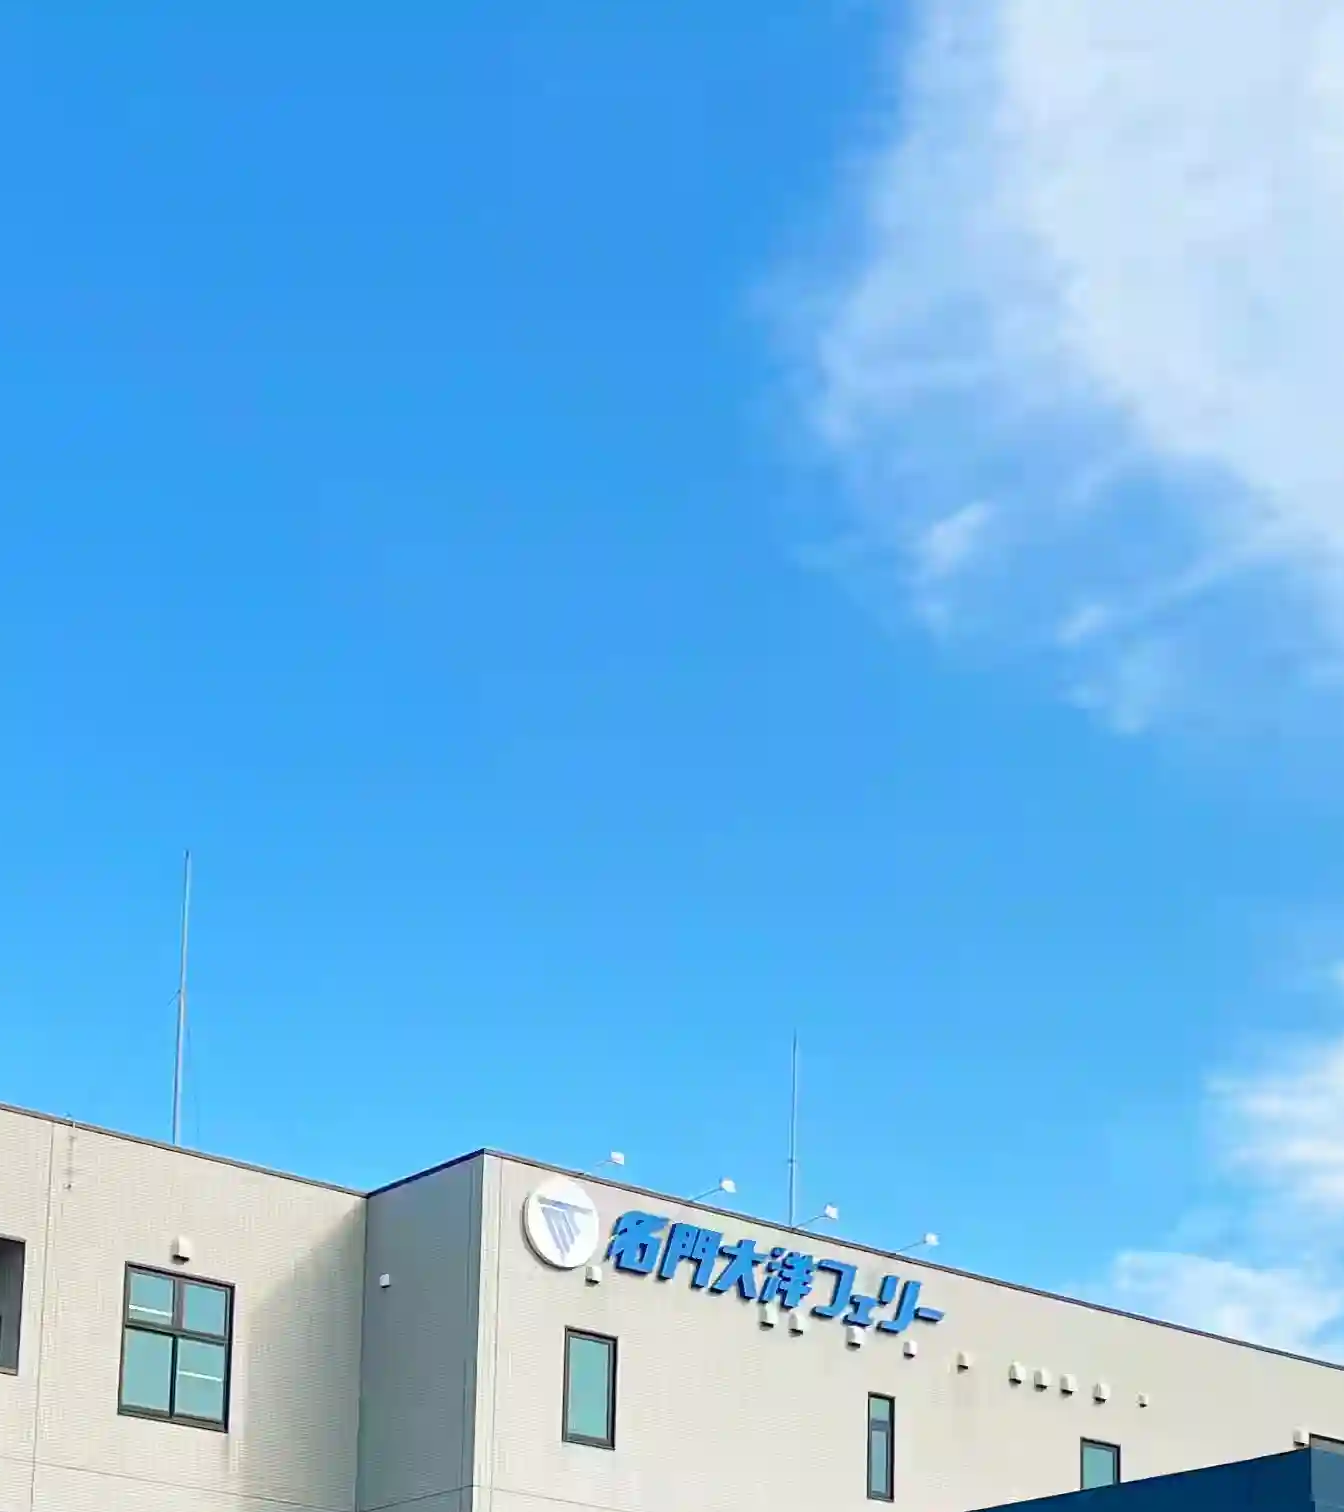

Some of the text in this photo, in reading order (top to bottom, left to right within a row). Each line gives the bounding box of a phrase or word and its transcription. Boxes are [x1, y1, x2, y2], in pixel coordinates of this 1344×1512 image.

[605, 1209, 945, 1334] 名門大洋フェリー
